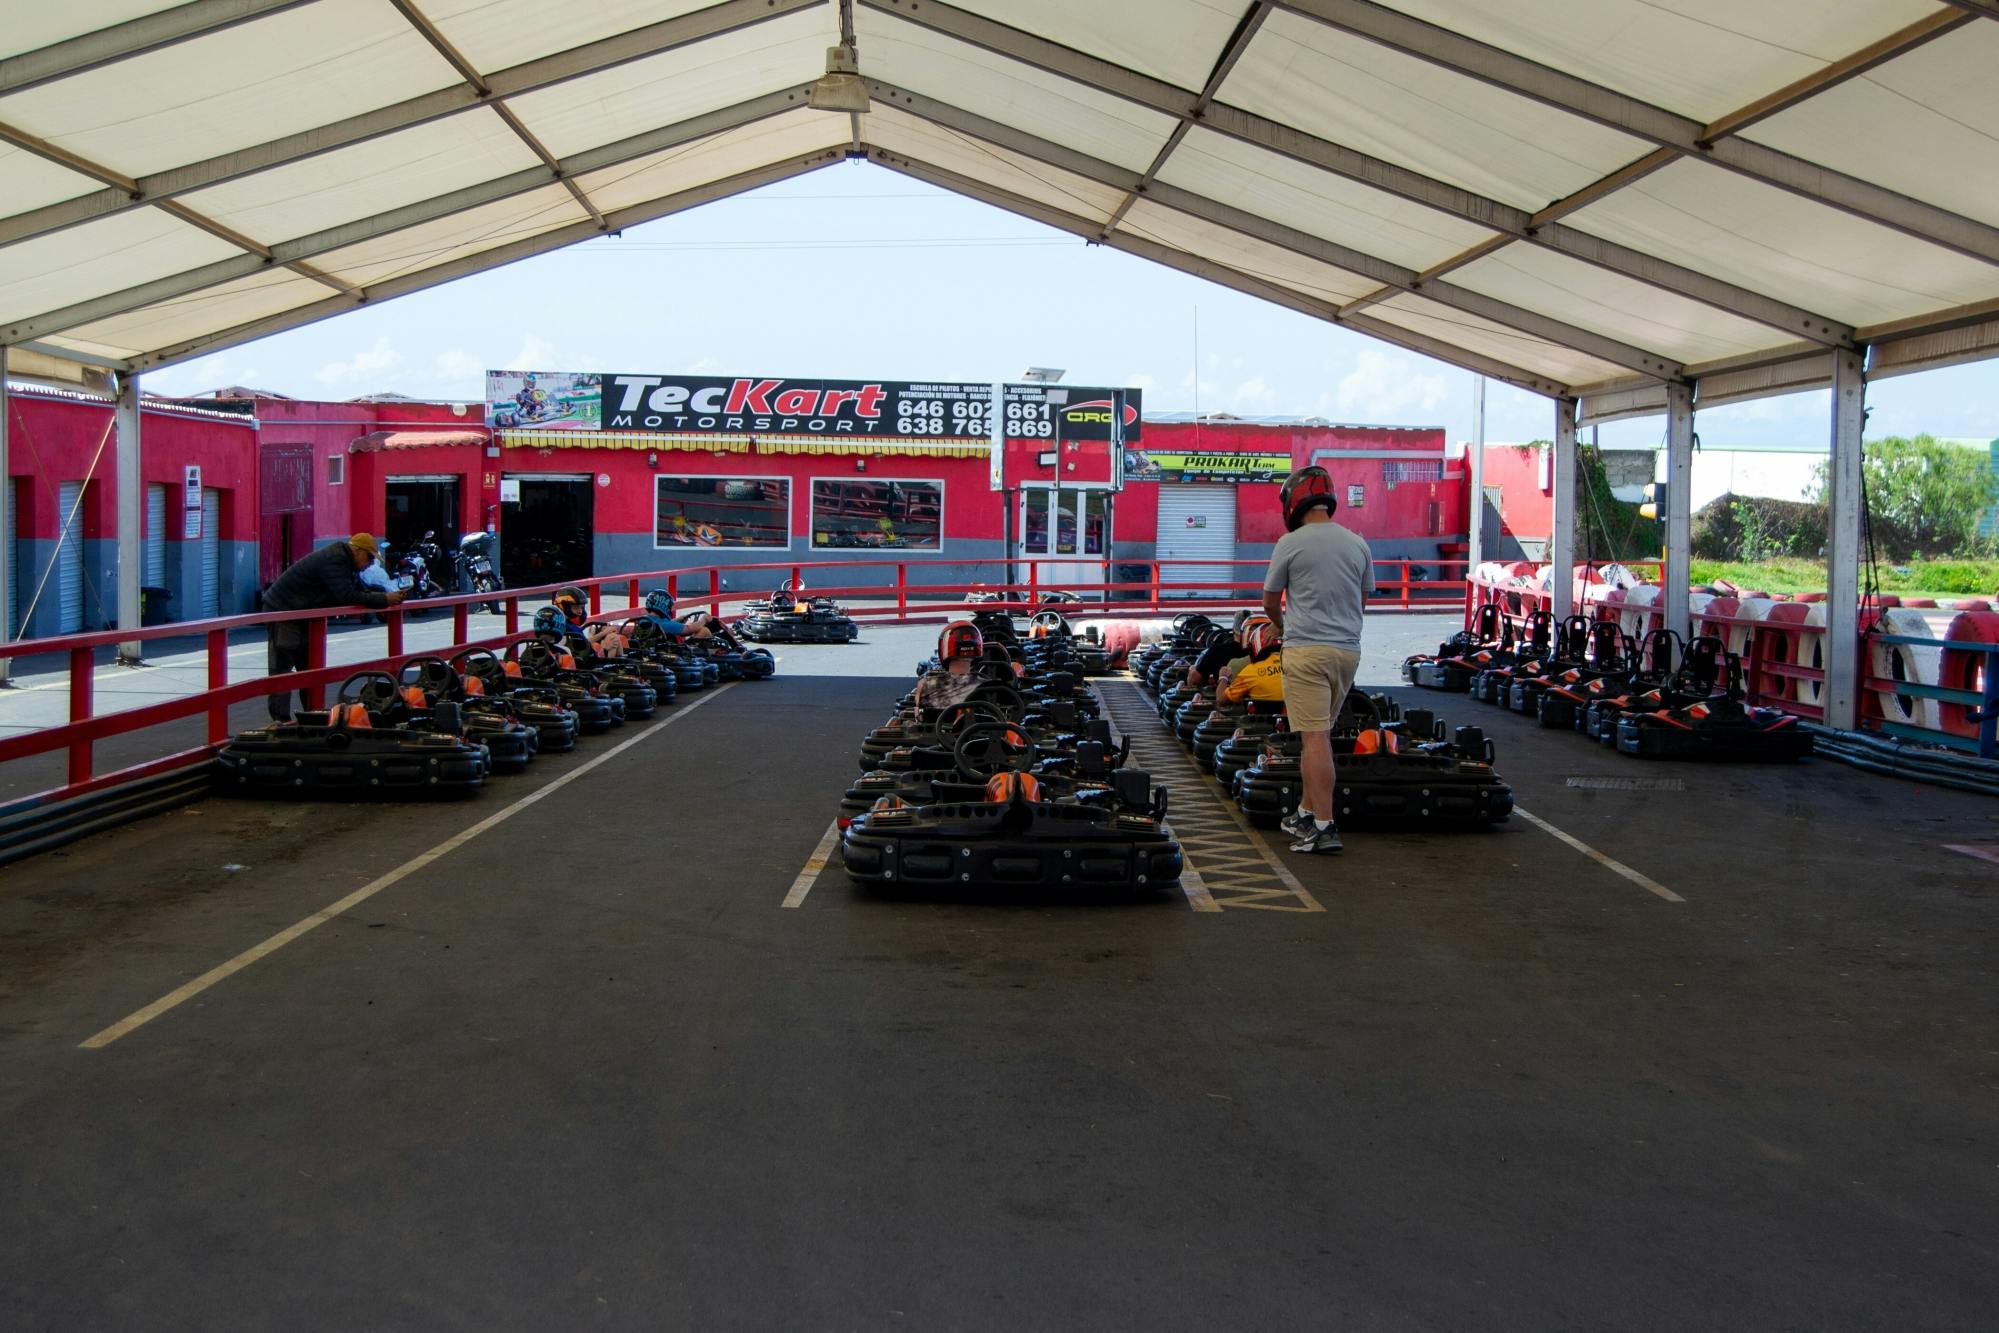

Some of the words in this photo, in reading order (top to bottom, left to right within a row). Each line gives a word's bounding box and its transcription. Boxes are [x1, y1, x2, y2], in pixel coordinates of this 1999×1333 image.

[614, 376, 887, 418] TecKart
[897, 400, 944, 417] 646
[1007, 402, 1050, 420] 661
[611, 415, 879, 432] MOTORSPORT
[897, 417, 944, 435] 638
[1006, 420, 1052, 438] 869
